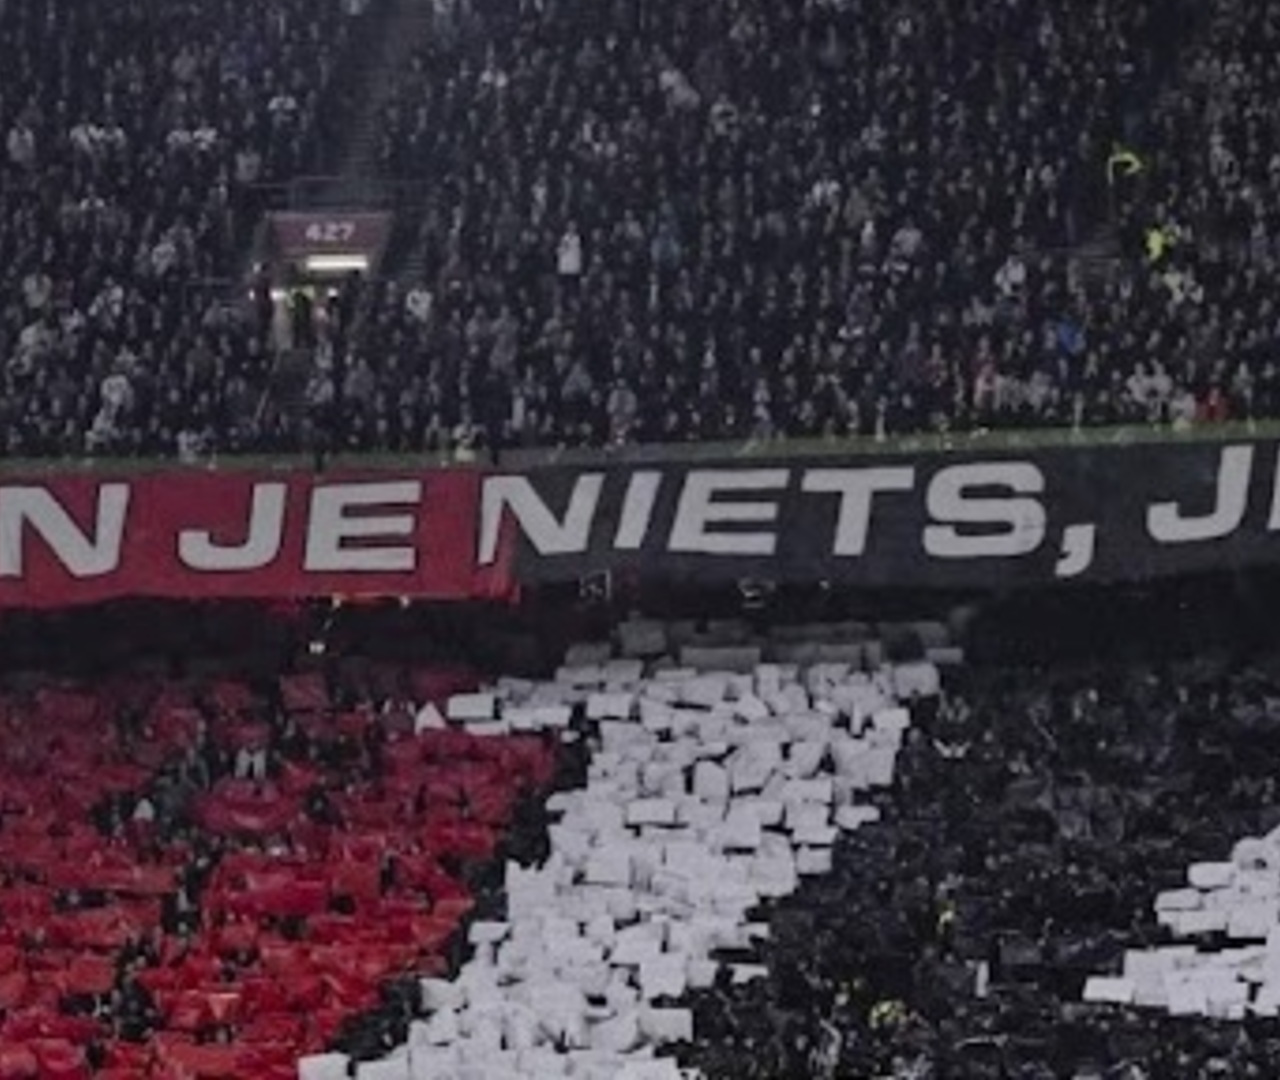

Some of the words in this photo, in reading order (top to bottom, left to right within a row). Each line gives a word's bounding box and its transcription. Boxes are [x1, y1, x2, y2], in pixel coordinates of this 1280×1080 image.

[305, 221, 356, 241] 427
[177, 481, 421, 571] JE
[477, 462, 1096, 577] NIETS,
